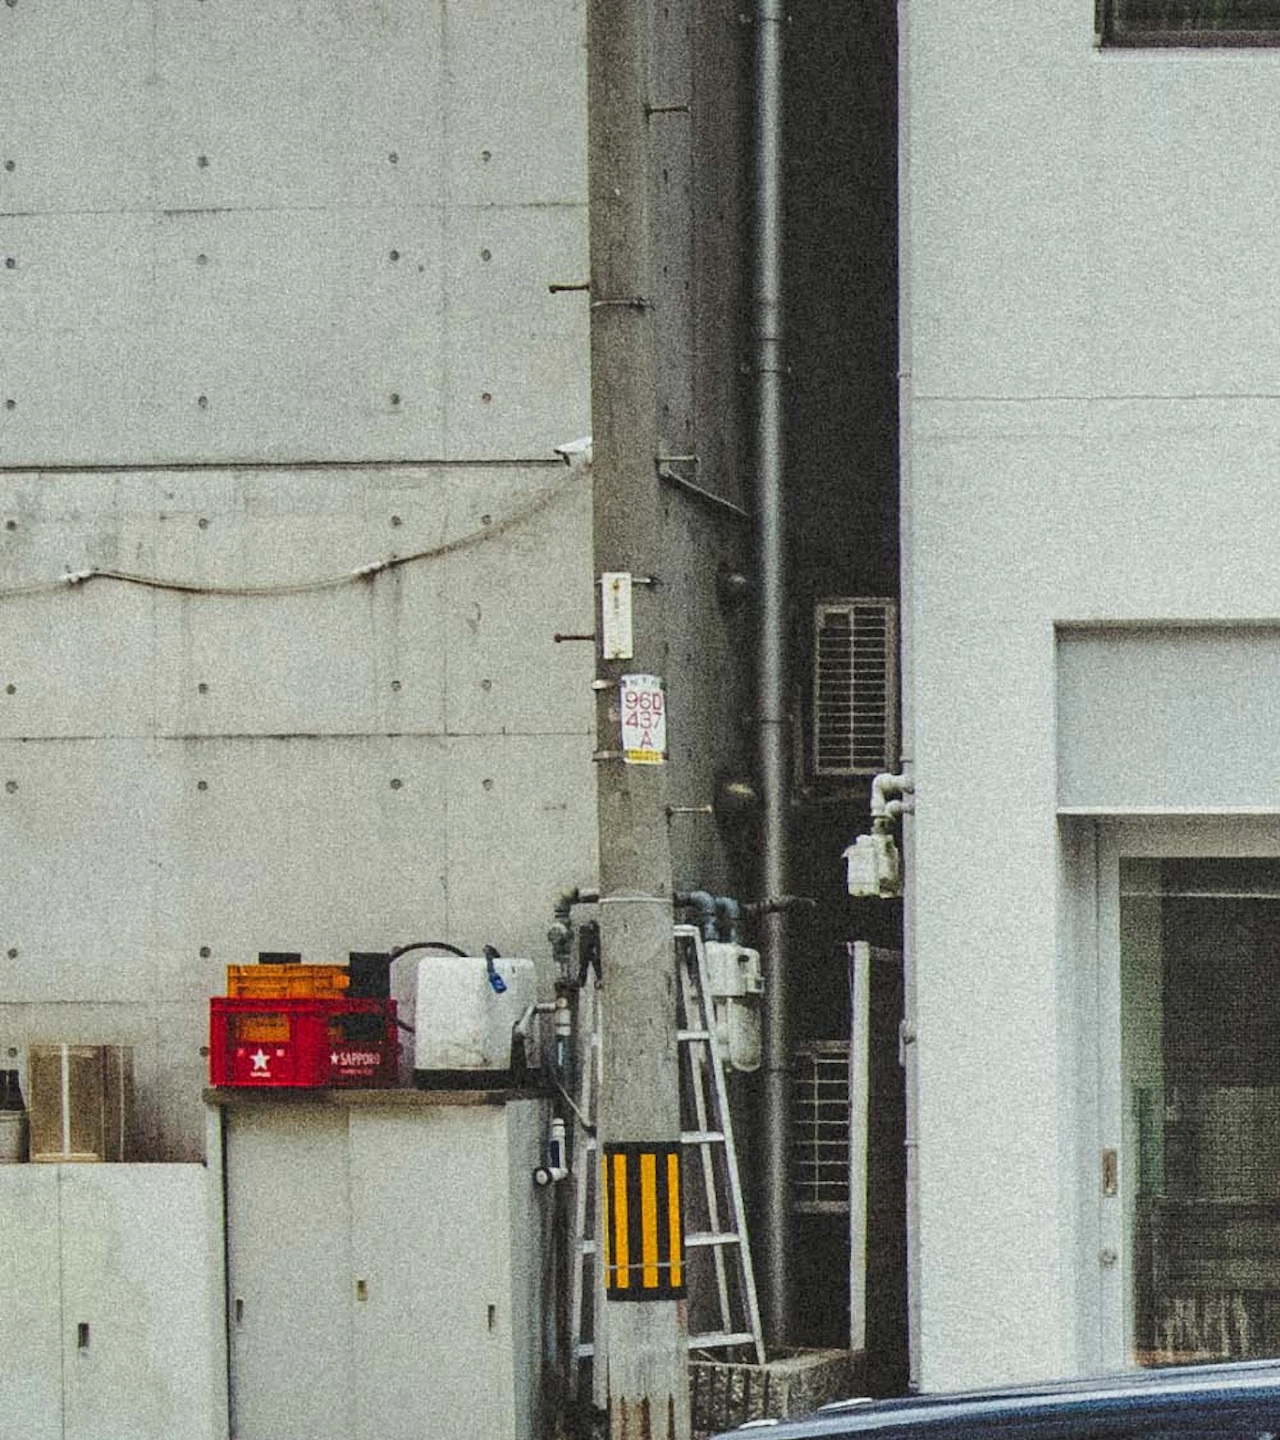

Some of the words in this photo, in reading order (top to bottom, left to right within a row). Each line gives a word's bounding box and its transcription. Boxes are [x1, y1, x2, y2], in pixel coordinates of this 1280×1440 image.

[625, 710, 663, 729] 437
[639, 730, 653, 748] A
[340, 1052, 381, 1066] SAPPORO
